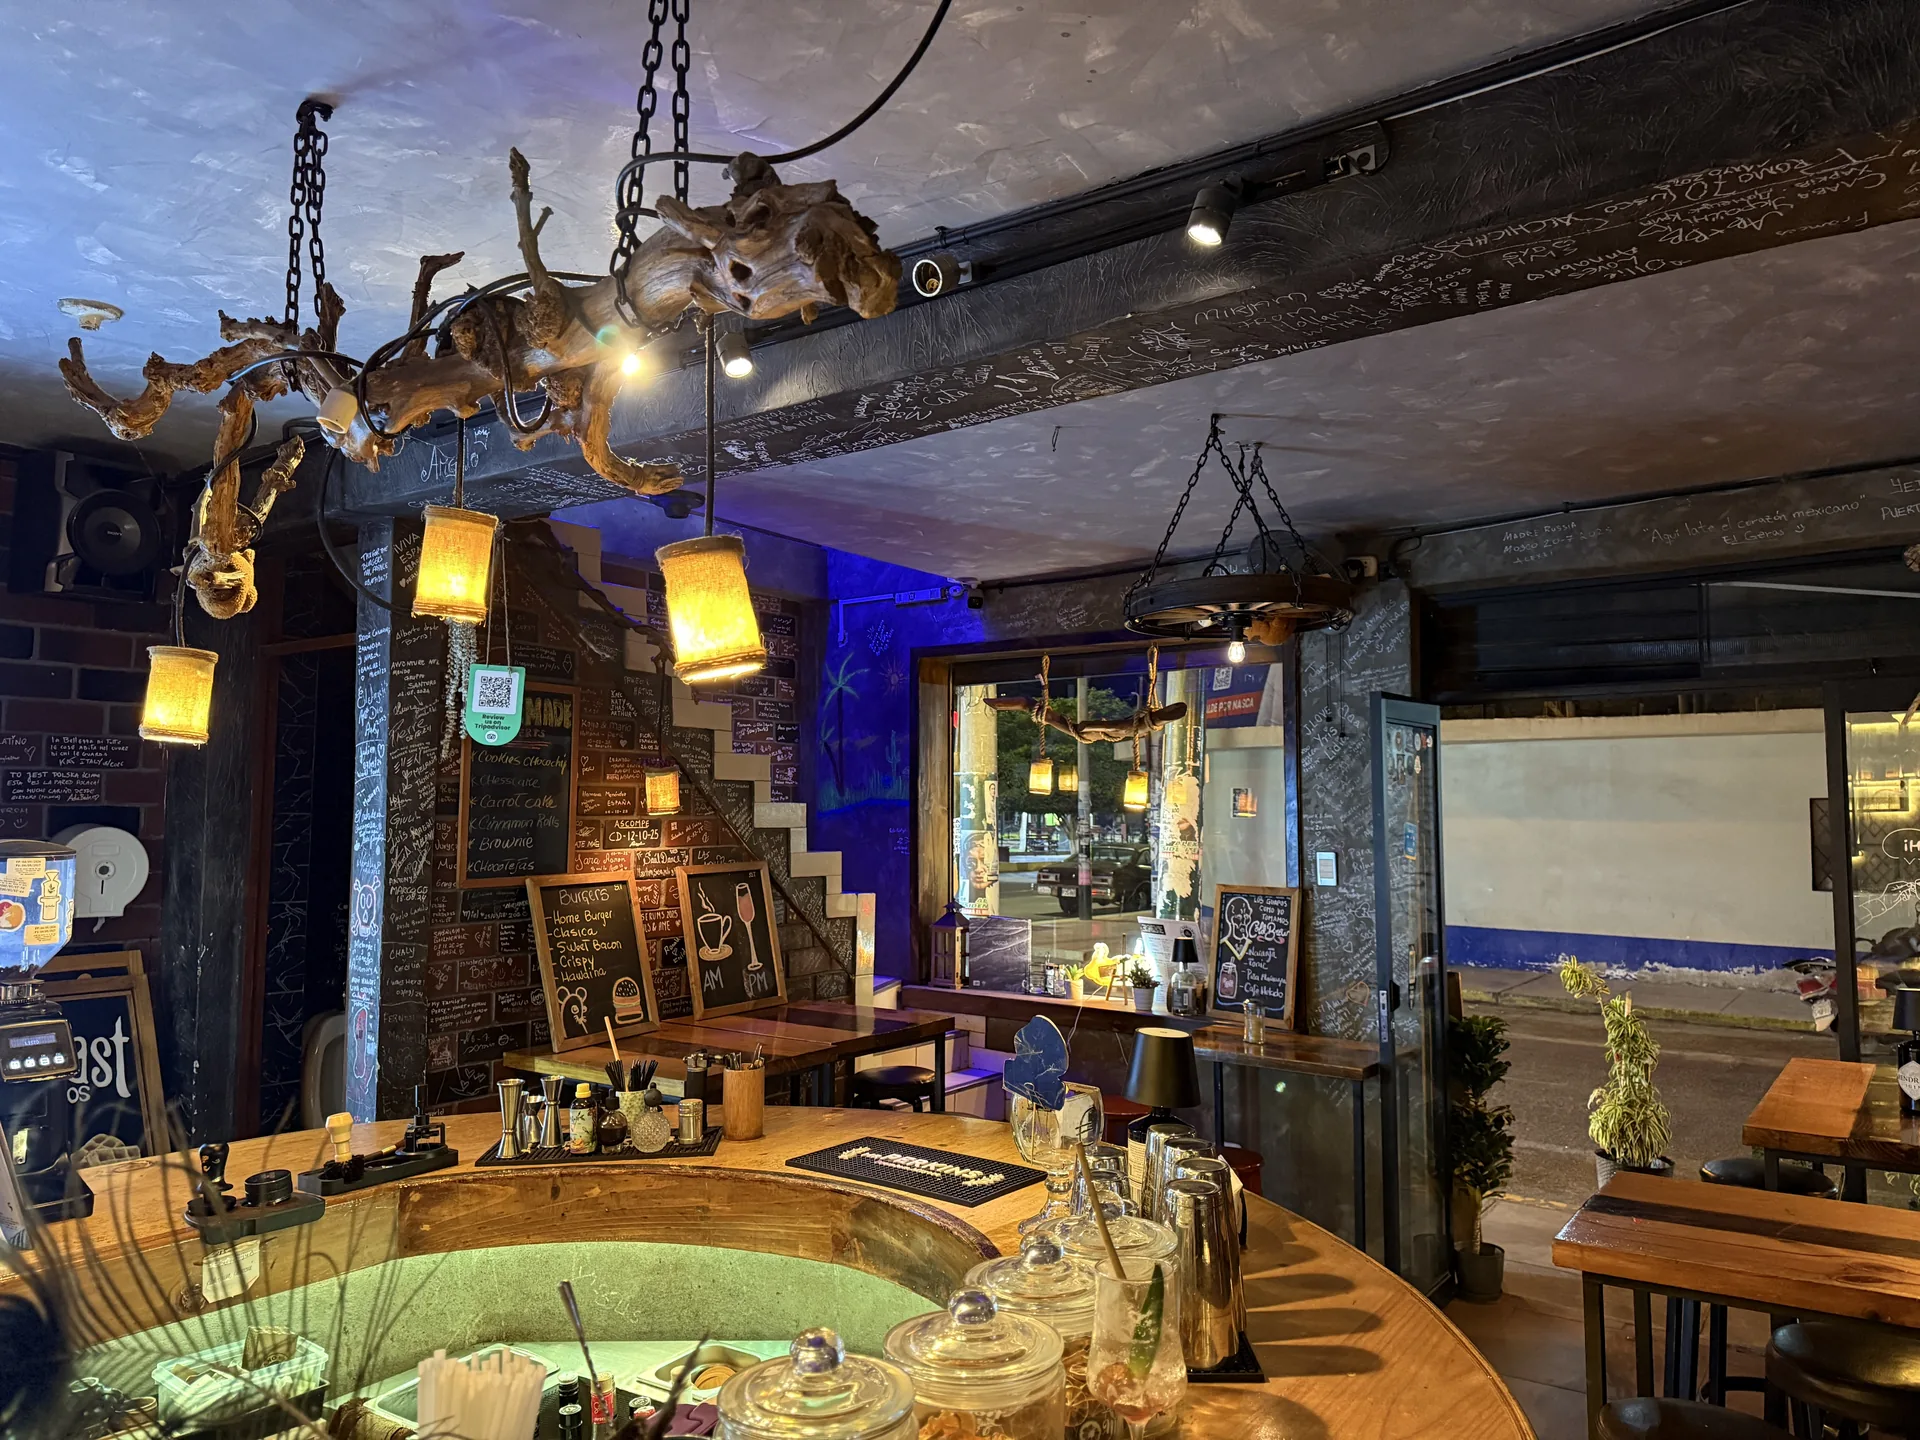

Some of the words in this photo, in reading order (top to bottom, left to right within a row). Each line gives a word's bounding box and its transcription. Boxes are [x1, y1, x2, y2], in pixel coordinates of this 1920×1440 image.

[1722, 517, 1731, 532] el
[1503, 529, 1540, 542] MADRE
[1232, 697, 1254, 710] NASCA
[525, 697, 572, 729] MADE
[607, 799, 631, 807] ESPAÑA
[614, 820, 650, 828] ASCOMPE
[559, 888, 610, 905] Burgers
[553, 910, 580, 925] Home
[584, 909, 613, 927] Burger
[553, 928, 598, 938] Clasica
[592, 939, 623, 952] Bacon
[559, 955, 595, 971] Crispy
[703, 966, 724, 993] AM
[749, 971, 769, 996] PM
